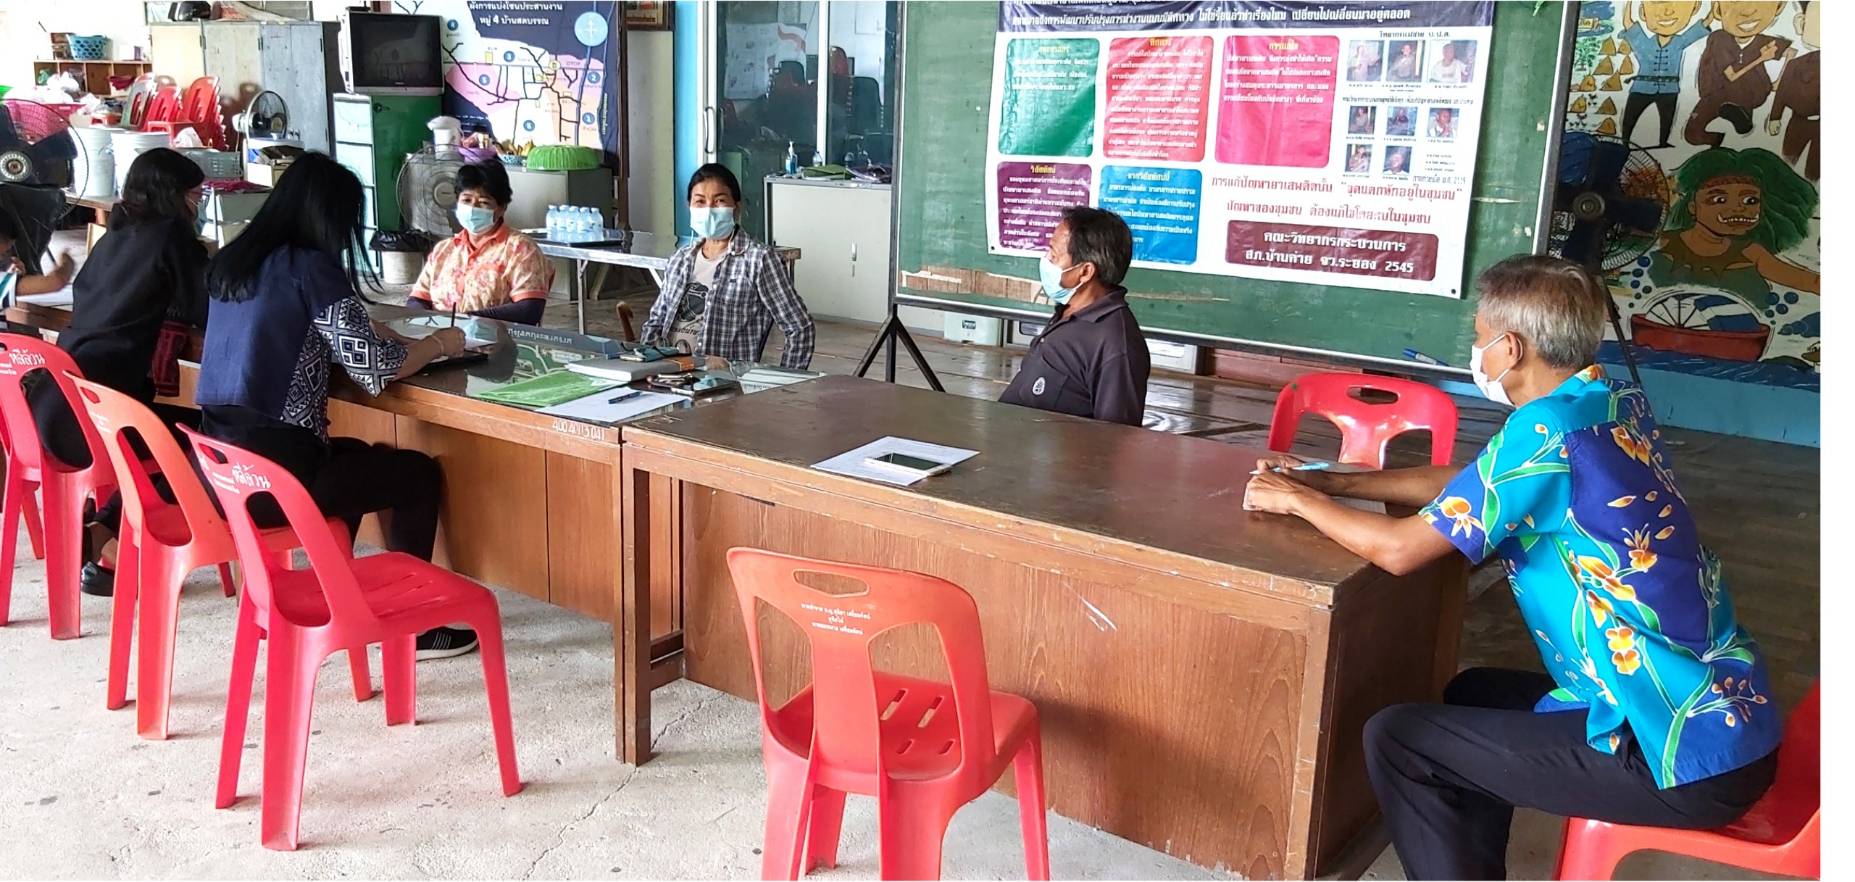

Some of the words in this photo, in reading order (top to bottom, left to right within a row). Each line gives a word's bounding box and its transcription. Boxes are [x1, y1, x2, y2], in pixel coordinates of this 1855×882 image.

[480, 14, 491, 27] หมู่
[493, 14, 500, 24] 4
[1227, 200, 1302, 217] ปัญหาของชุมชน
[1264, 230, 1406, 252] คณะวิทยากรกระบวนการ
[1320, 256, 1377, 271] จว.ระยอง
[1385, 260, 1414, 273] 2545
